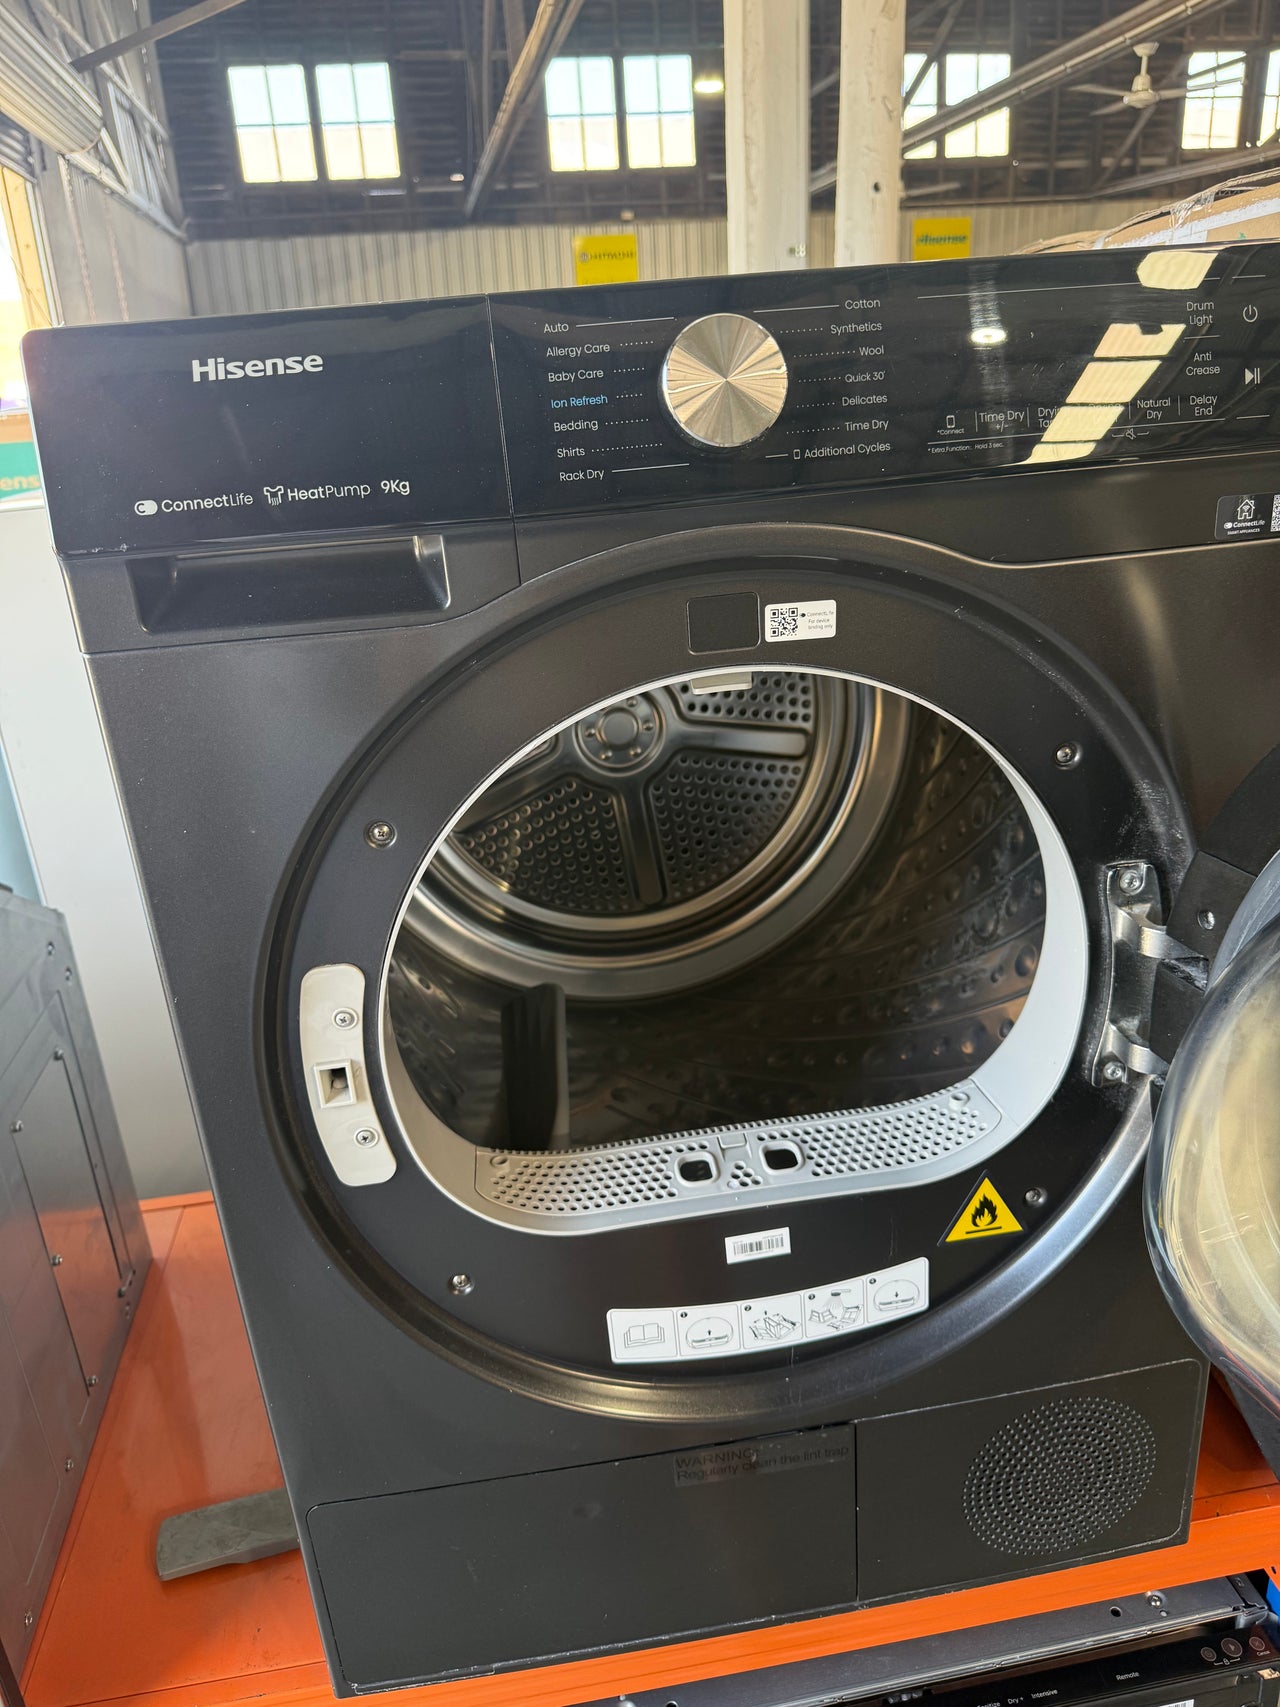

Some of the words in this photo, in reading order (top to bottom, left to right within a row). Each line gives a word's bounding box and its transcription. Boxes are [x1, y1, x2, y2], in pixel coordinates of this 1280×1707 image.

[844, 299, 881, 310] Cotton
[1186, 301, 1215, 311] Drum
[1189, 313, 1214, 327] Light
[543, 322, 569, 334] Auto
[830, 321, 882, 336] Synthetics
[546, 345, 582, 358] Allergy
[584, 343, 611, 354] Care
[859, 345, 885, 357] Wool
[1193, 352, 1212, 363] Anti
[192, 353, 323, 382] Hisense
[1185, 364, 1221, 376] Crease
[548, 371, 575, 383] Baby
[577, 369, 604, 380] Care
[844, 372, 871, 383] Quick
[550, 398, 568, 409] Ion
[569, 394, 608, 407] Refresh
[842, 395, 888, 406] Delicates
[1136, 397, 1171, 409] Natural
[1189, 395, 1218, 406] Delay
[979, 412, 1005, 423] Time
[1007, 410, 1025, 422] Dry
[1146, 409, 1163, 421] Dry
[1194, 406, 1213, 416] End
[553, 419, 599, 432] Bedding
[844, 420, 870, 432] Time
[871, 419, 889, 431] Dry
[556, 447, 586, 458] Shirts
[804, 444, 856, 459] Additional
[857, 441, 891, 455] Cycles
[559, 470, 585, 482] Rack
[586, 469, 605, 481] Dry
[287, 482, 371, 501] HeatPump
[380, 479, 410, 496] 9Kg
[161, 492, 254, 513] ConnectLife
[677, 1464, 738, 1481] Regularly
[780, 1453, 800, 1465] the
[803, 1449, 821, 1461] lint
[824, 1447, 849, 1461] trap
[1115, 1671, 1140, 1681] Remote
[1031, 1688, 1059, 1699] Intensive
[1007, 1697, 1019, 1705] Dry
